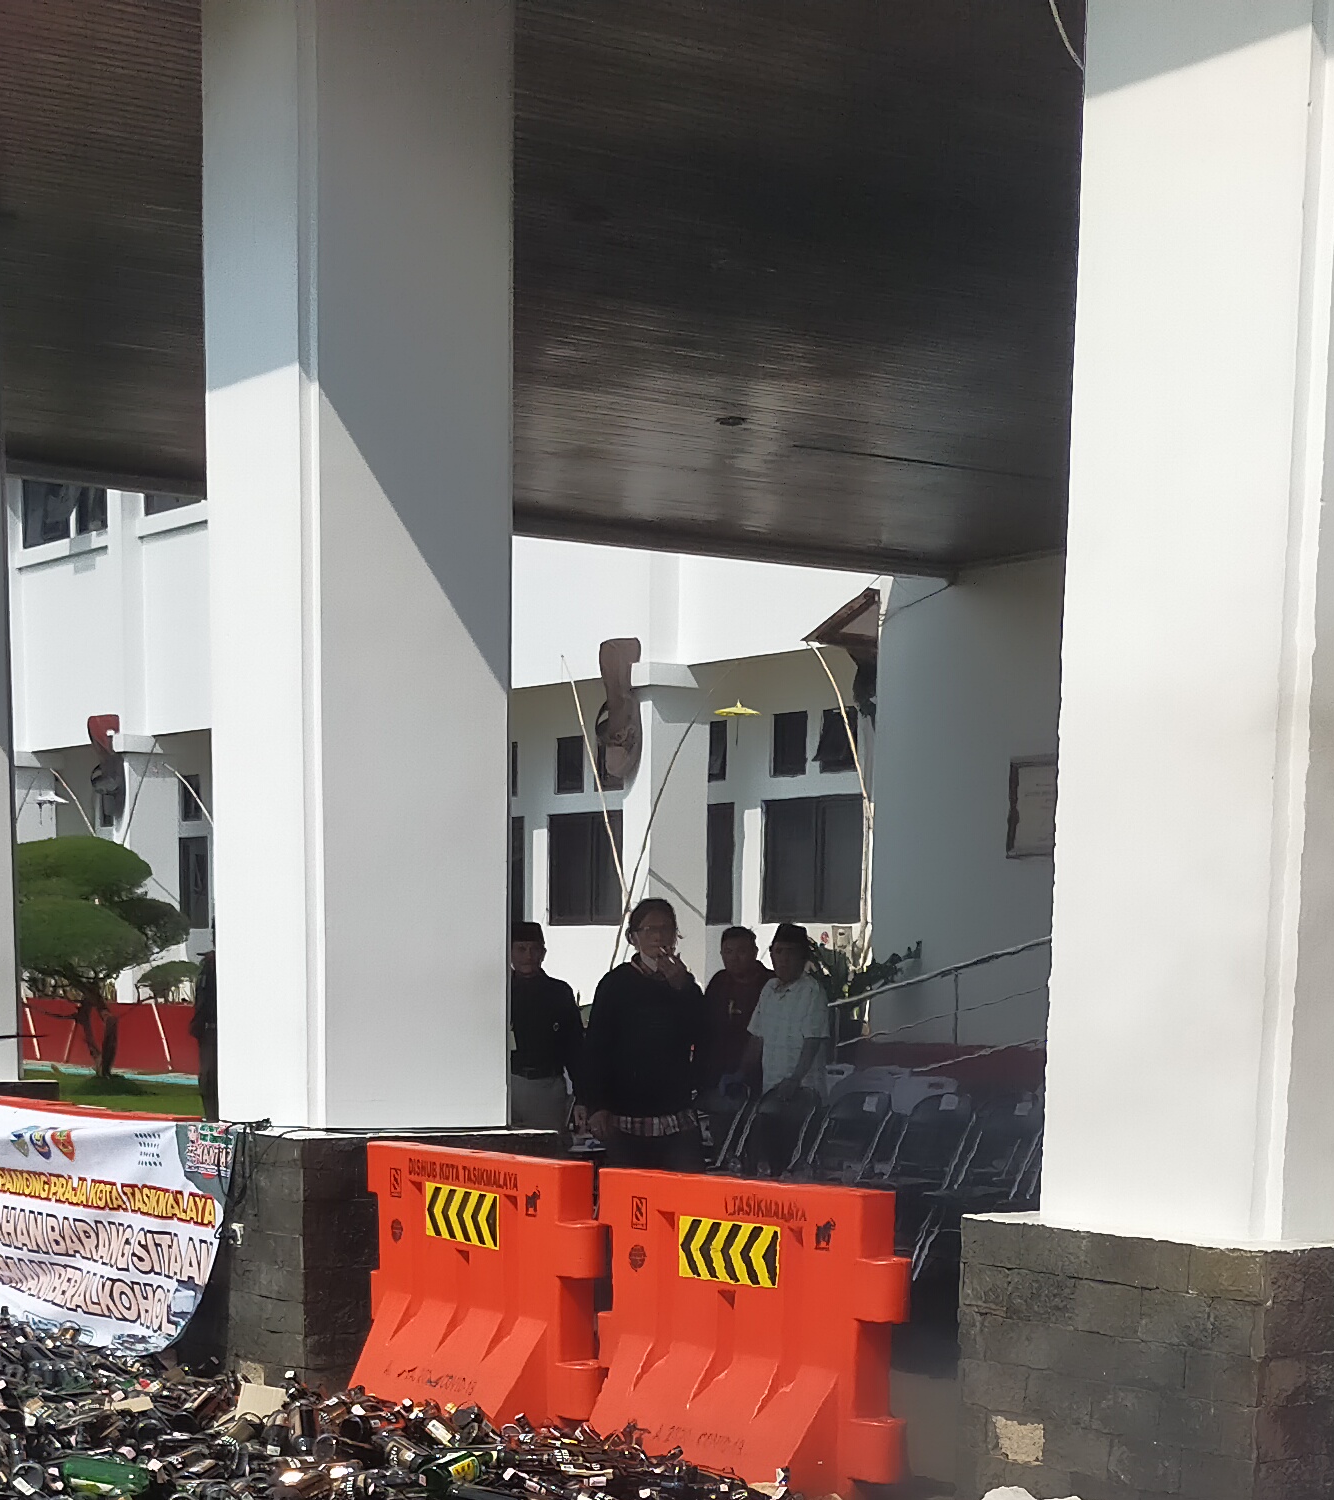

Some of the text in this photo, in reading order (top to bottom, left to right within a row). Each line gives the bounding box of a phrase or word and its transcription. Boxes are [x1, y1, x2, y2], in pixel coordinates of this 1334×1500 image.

[48, 1172, 88, 1208] PRAJA
[86, 1179, 128, 1211] KOTA
[121, 1183, 216, 1229] TASIKMALAYA
[408, 1158, 518, 1192] DISHUB KOTA TASIKMALAYA
[45, 1213, 135, 1273] BARANG
[131, 1226, 214, 1286] SITAAN
[44, 1261, 178, 1336] BERALKOHOL
